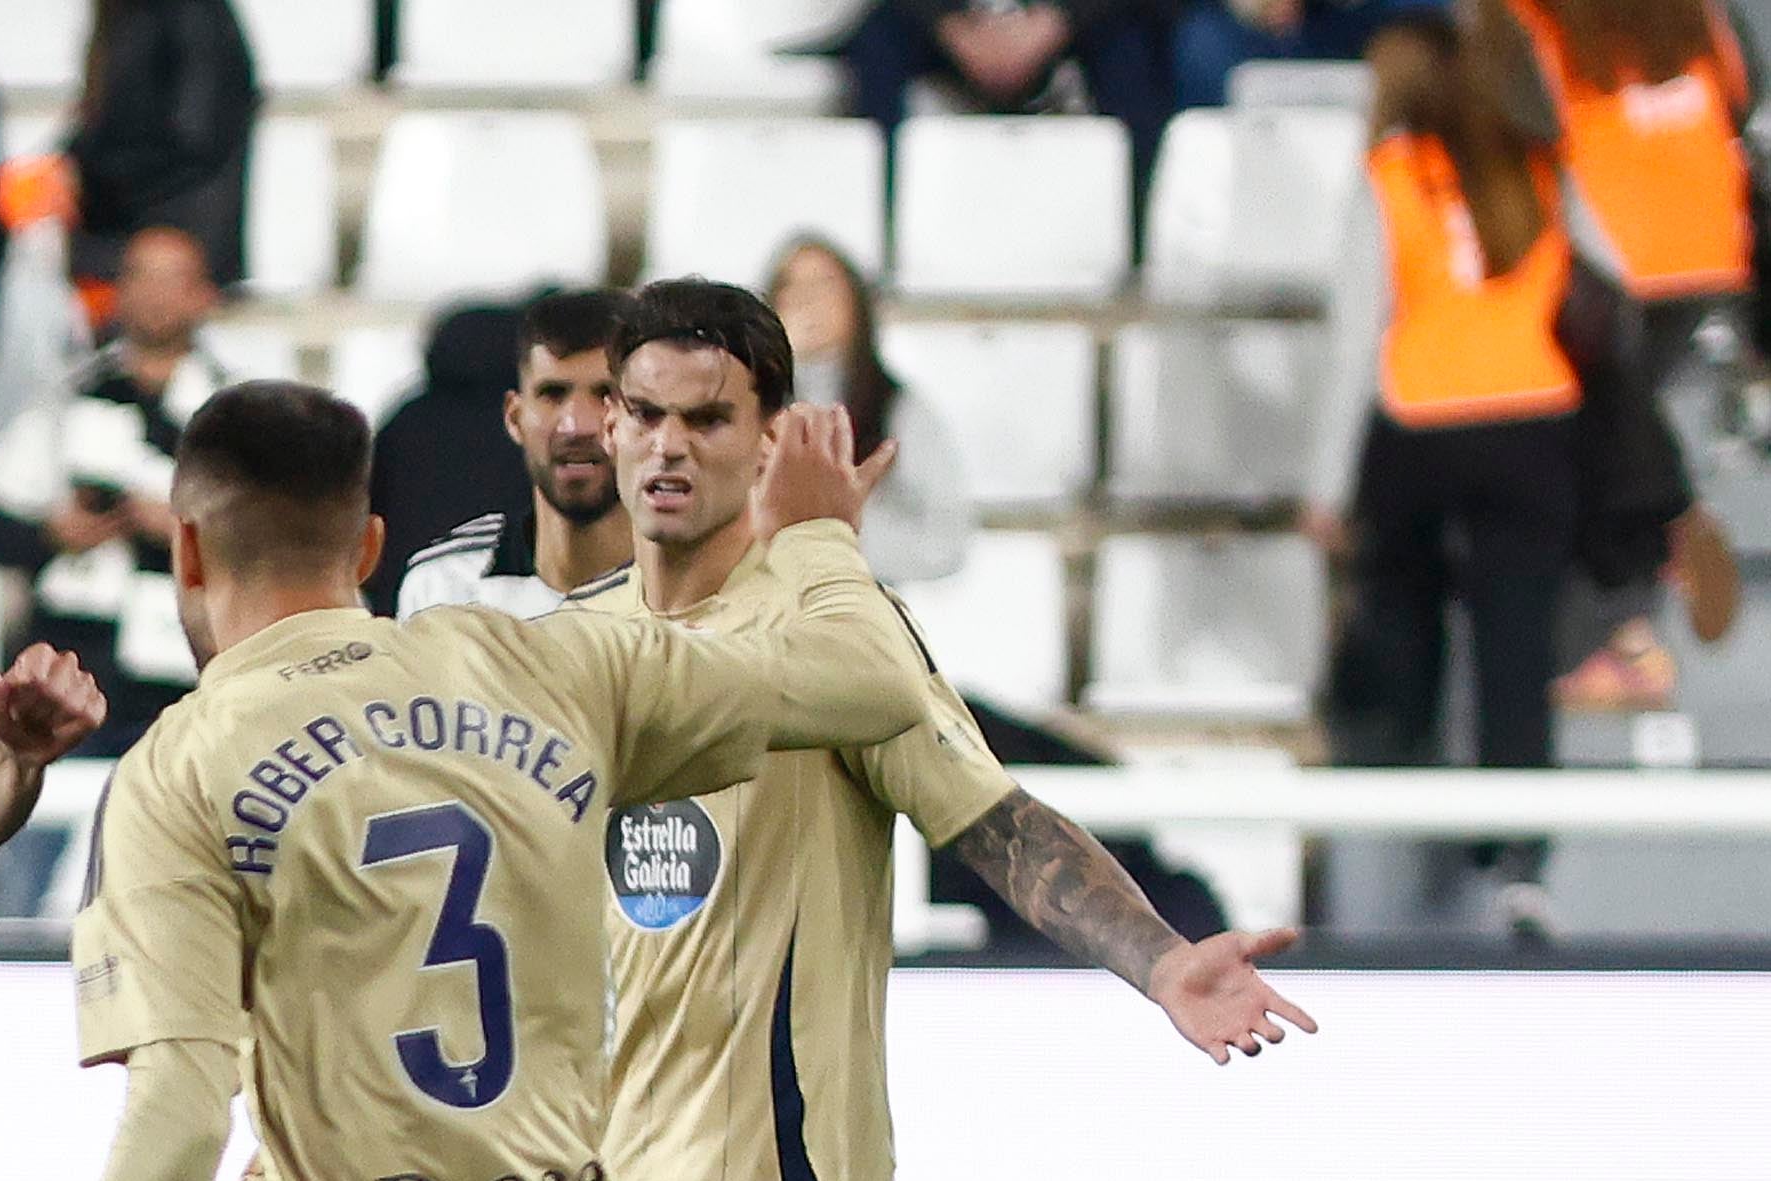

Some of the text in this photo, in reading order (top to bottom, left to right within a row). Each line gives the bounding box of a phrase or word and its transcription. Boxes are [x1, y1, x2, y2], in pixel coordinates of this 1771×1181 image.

[225, 696, 599, 875] ROBER CORREA
[620, 815, 698, 853] Estrella
[624, 851, 692, 892] Galicia
[360, 800, 515, 1111] 3
